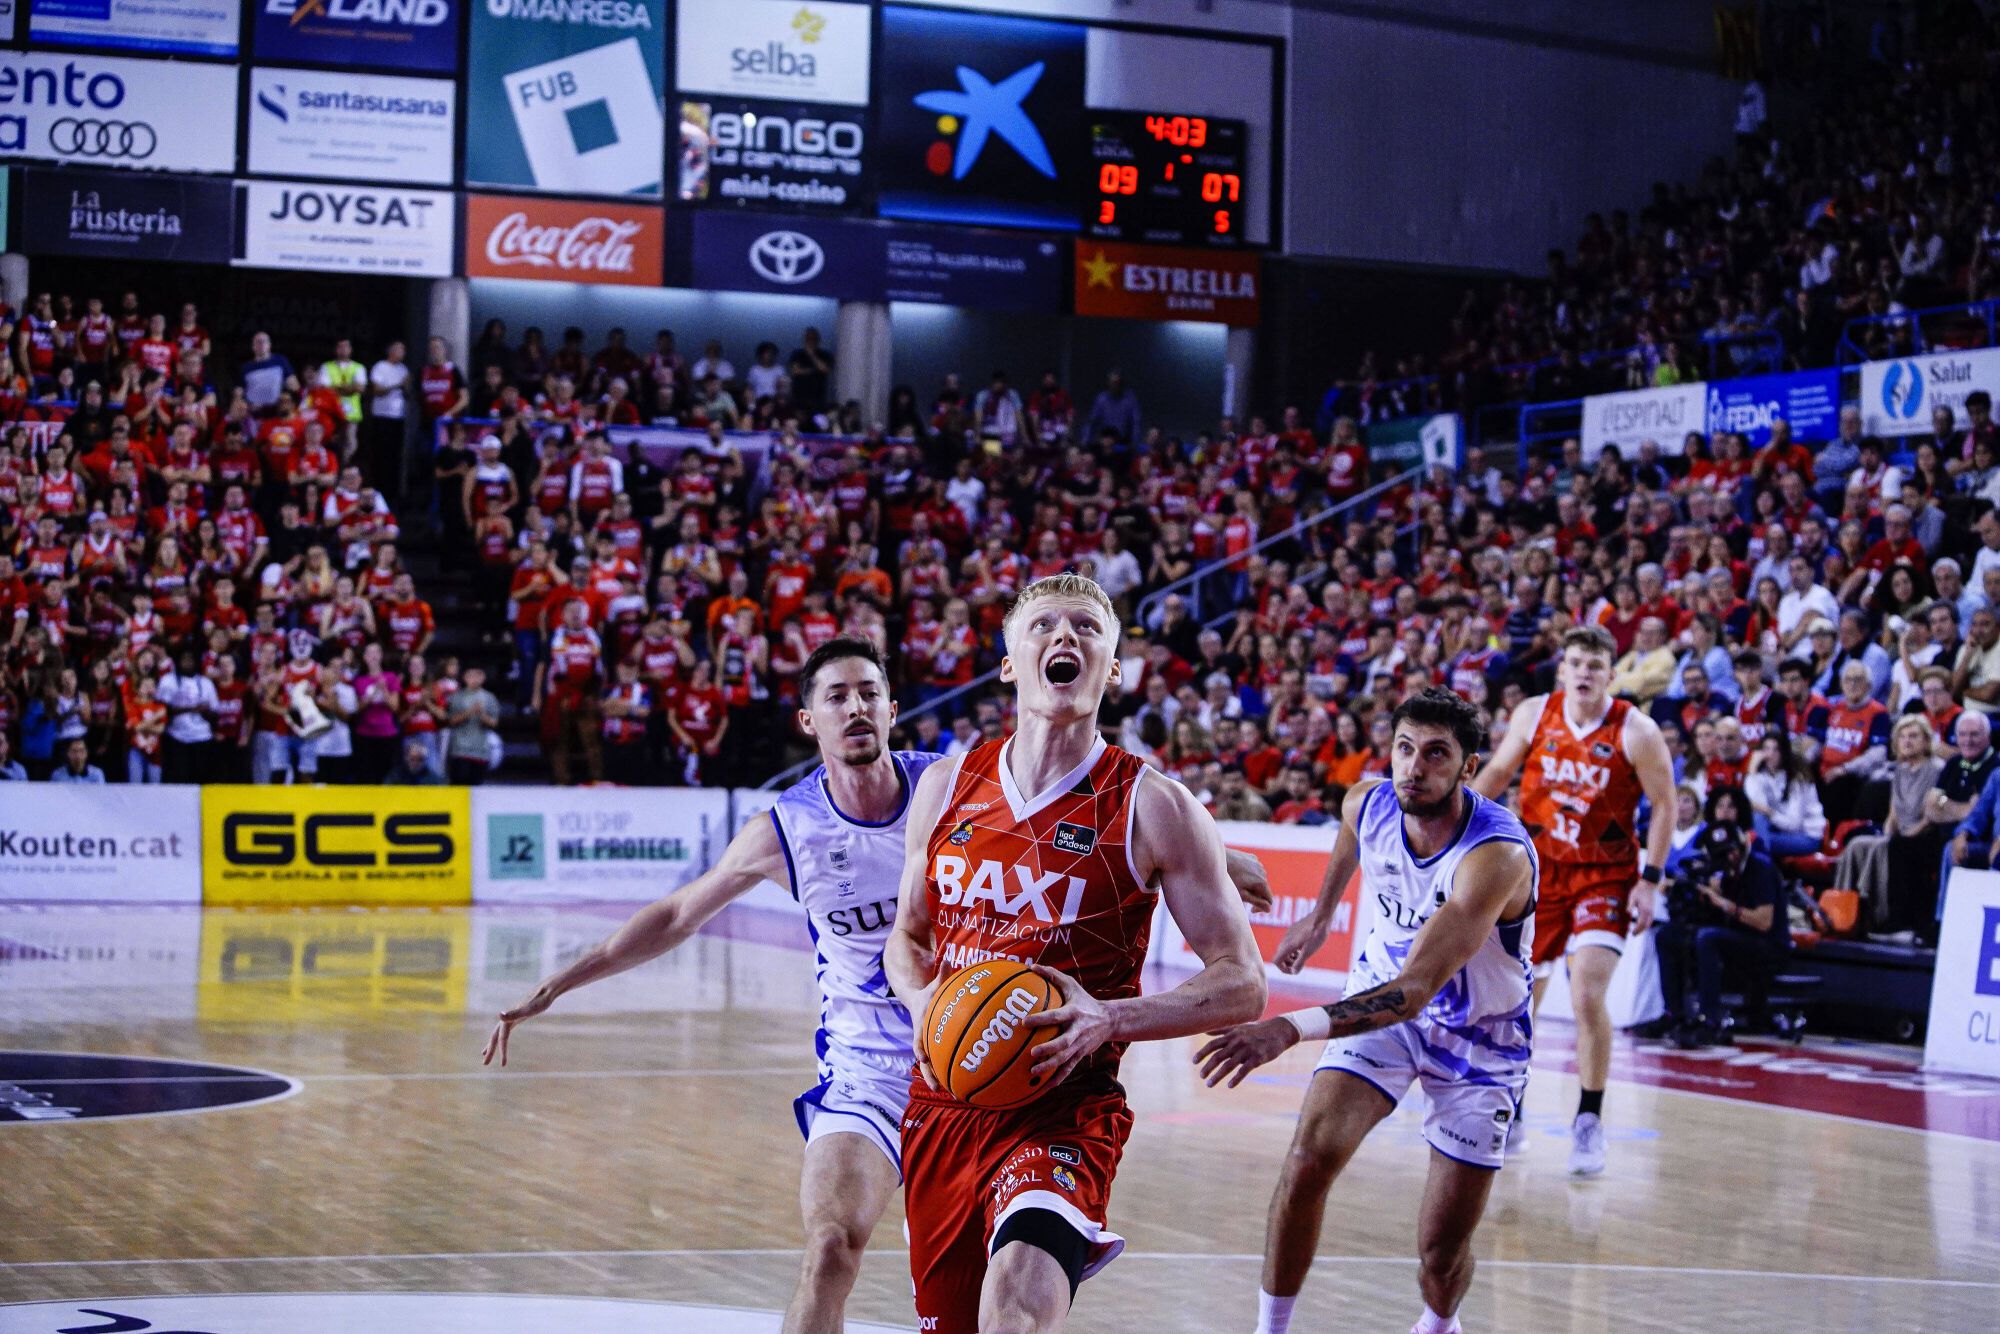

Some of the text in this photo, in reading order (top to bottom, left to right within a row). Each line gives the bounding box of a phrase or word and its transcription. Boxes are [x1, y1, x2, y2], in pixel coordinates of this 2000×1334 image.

[731, 41, 817, 77] selba
[298, 90, 448, 116] santasusana
[519, 70, 578, 108] FUB
[1145, 115, 1208, 148] 4:03
[1098, 163, 1139, 196] 09
[1201, 172, 1241, 203] 07
[270, 190, 434, 229] JOYSAT
[1098, 200, 1116, 230] 3
[1123, 263, 1257, 298] ESTRELLA
[1929, 359, 1972, 386] Salut
[1541, 755, 1611, 790] BAXI
[223, 812, 454, 866] GCS
[558, 837, 684, 861] WE PROTECT
[1057, 839, 1090, 852] endesa
[1059, 830, 1075, 840] liga
[936, 854, 1088, 925] BAXI
[827, 897, 898, 937] SU
[934, 969, 992, 1044] liga endesa
[959, 987, 1039, 1073] Wilson
[1968, 1010, 2000, 1044] CL
[1439, 1125, 1478, 1149] NISSAN
[1051, 1150, 1073, 1161] acb
